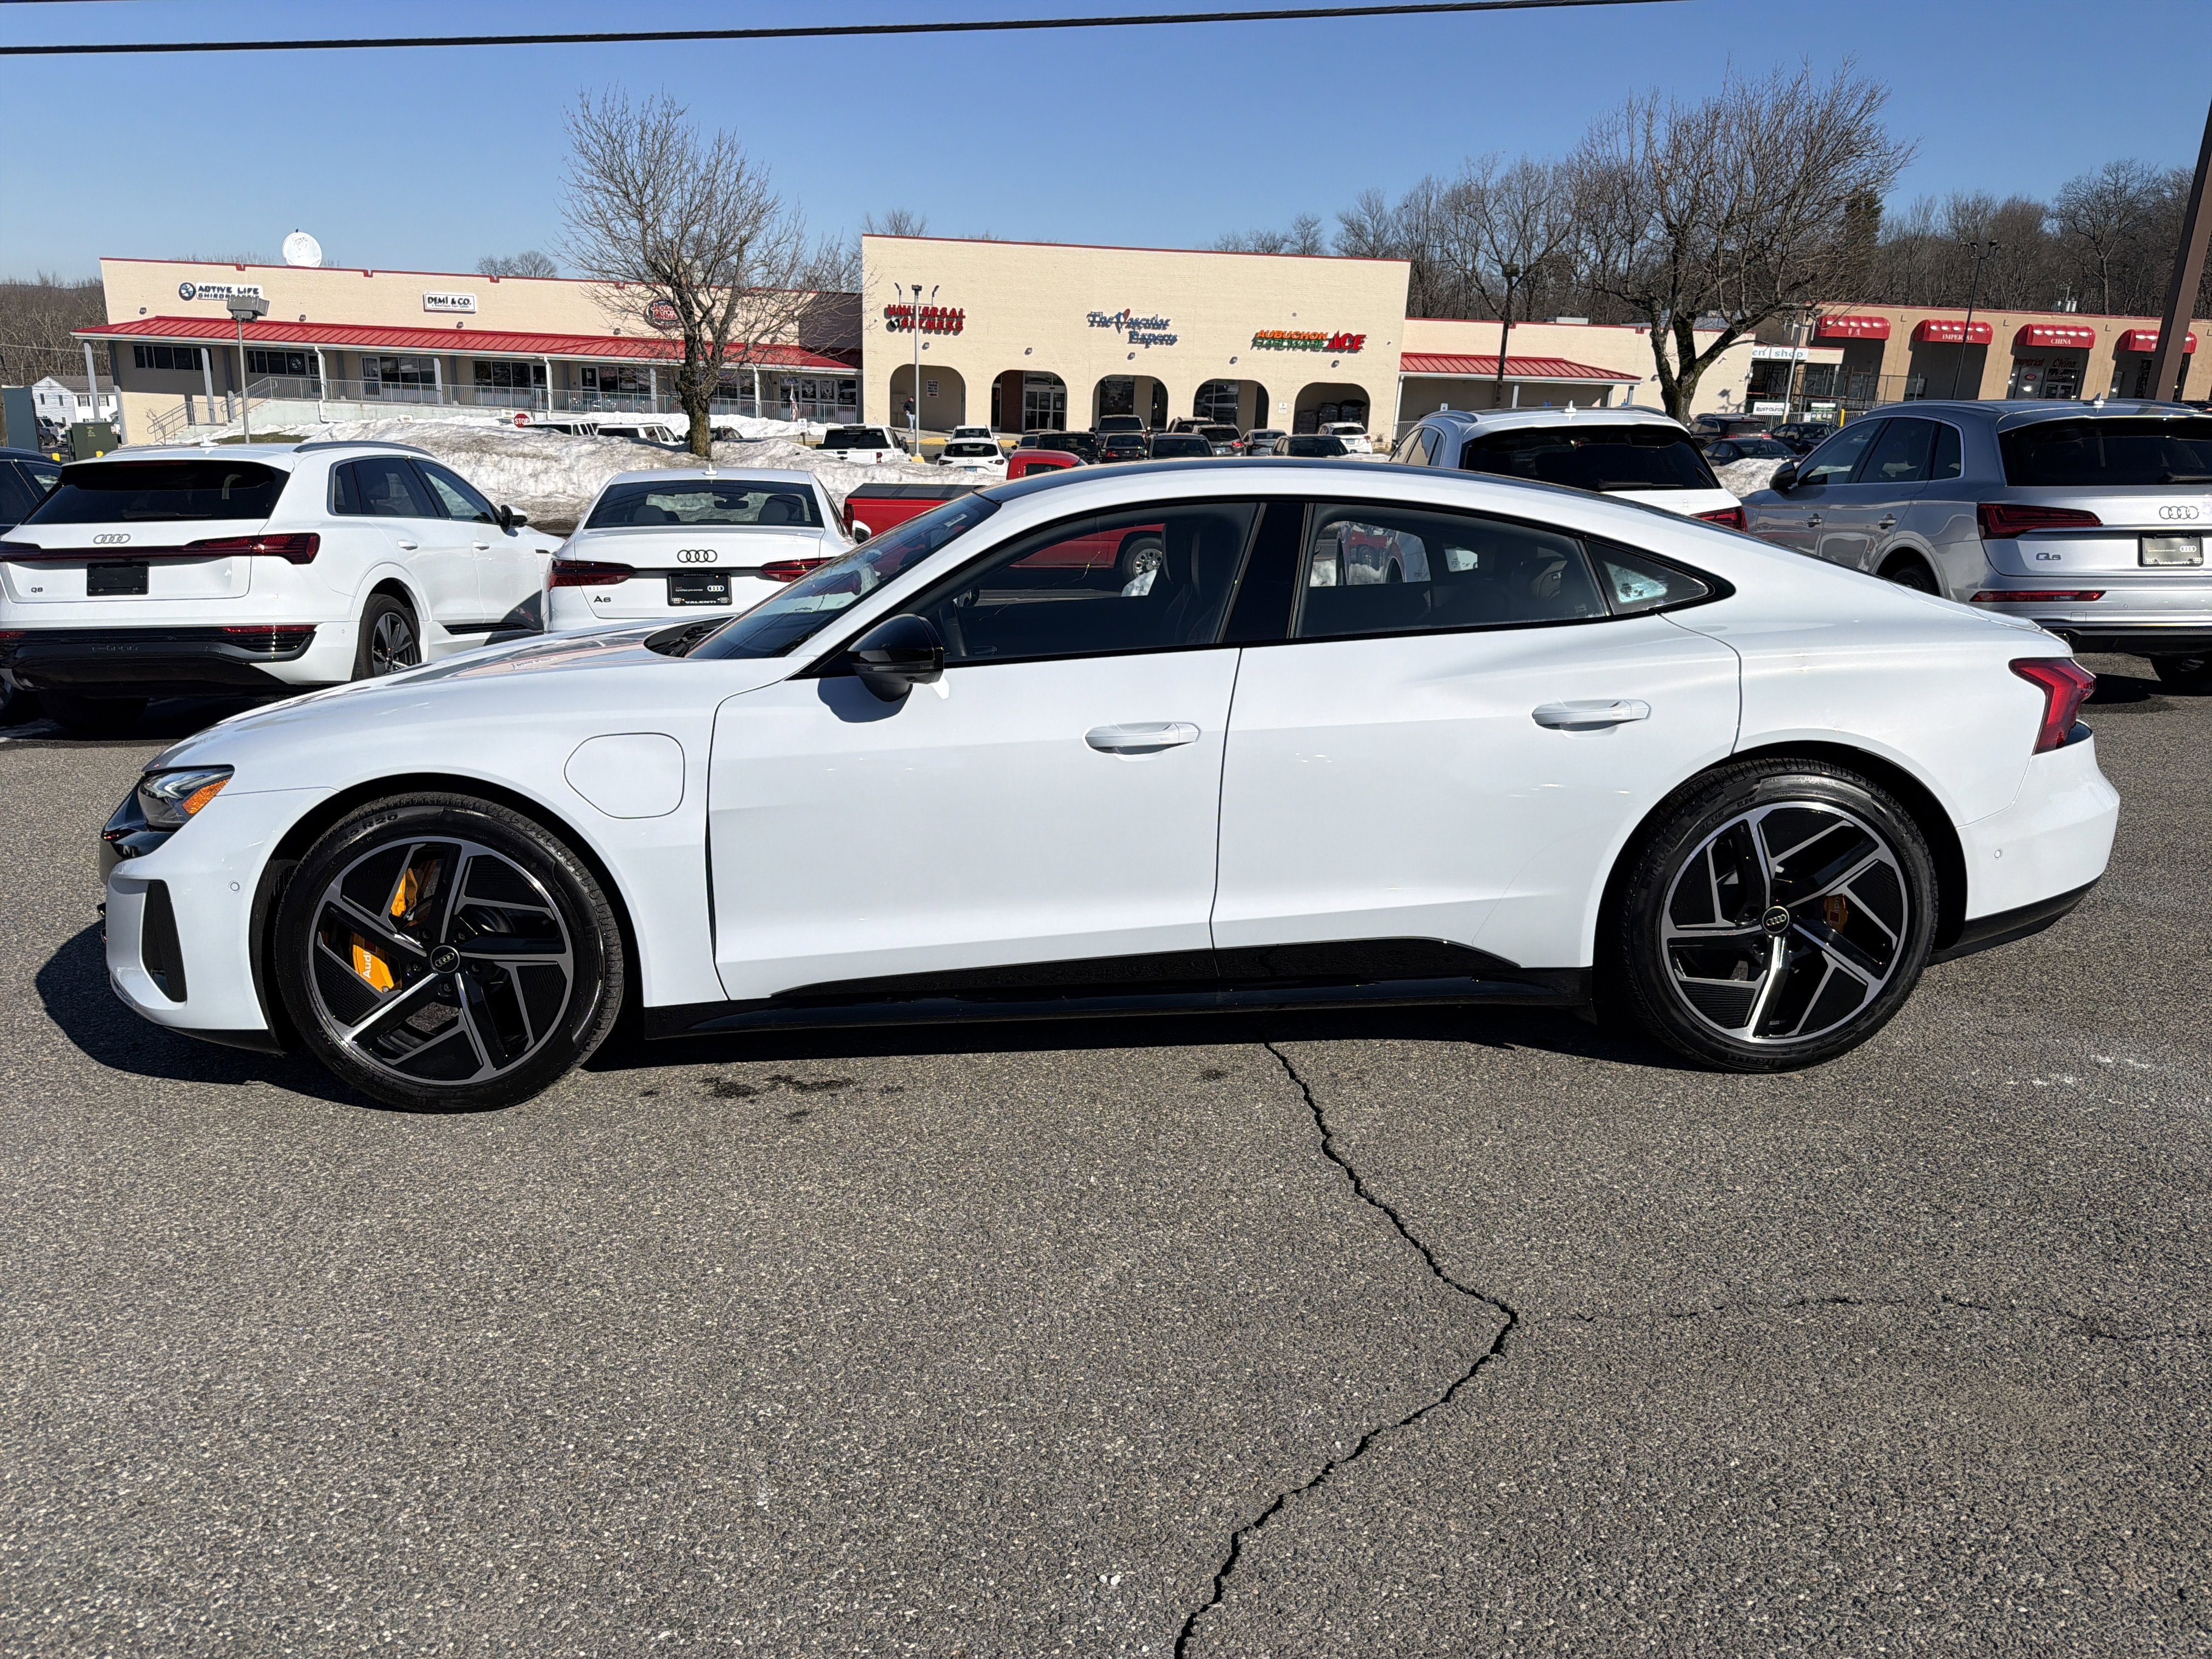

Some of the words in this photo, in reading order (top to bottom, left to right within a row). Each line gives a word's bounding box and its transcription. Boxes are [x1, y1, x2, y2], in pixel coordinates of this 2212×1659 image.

[427, 296, 448, 304] DEMI
[652, 303, 675, 312] Jerse
[887, 304, 966, 319] UNIVERSAL
[900, 317, 964, 332] FITNESS
[1087, 311, 1115, 328] The
[1256, 330, 1329, 340] AUBUCHON
[1327, 330, 1367, 350] ACE
[1774, 349, 1803, 359] shop
[2015, 358, 2045, 366] mperial
